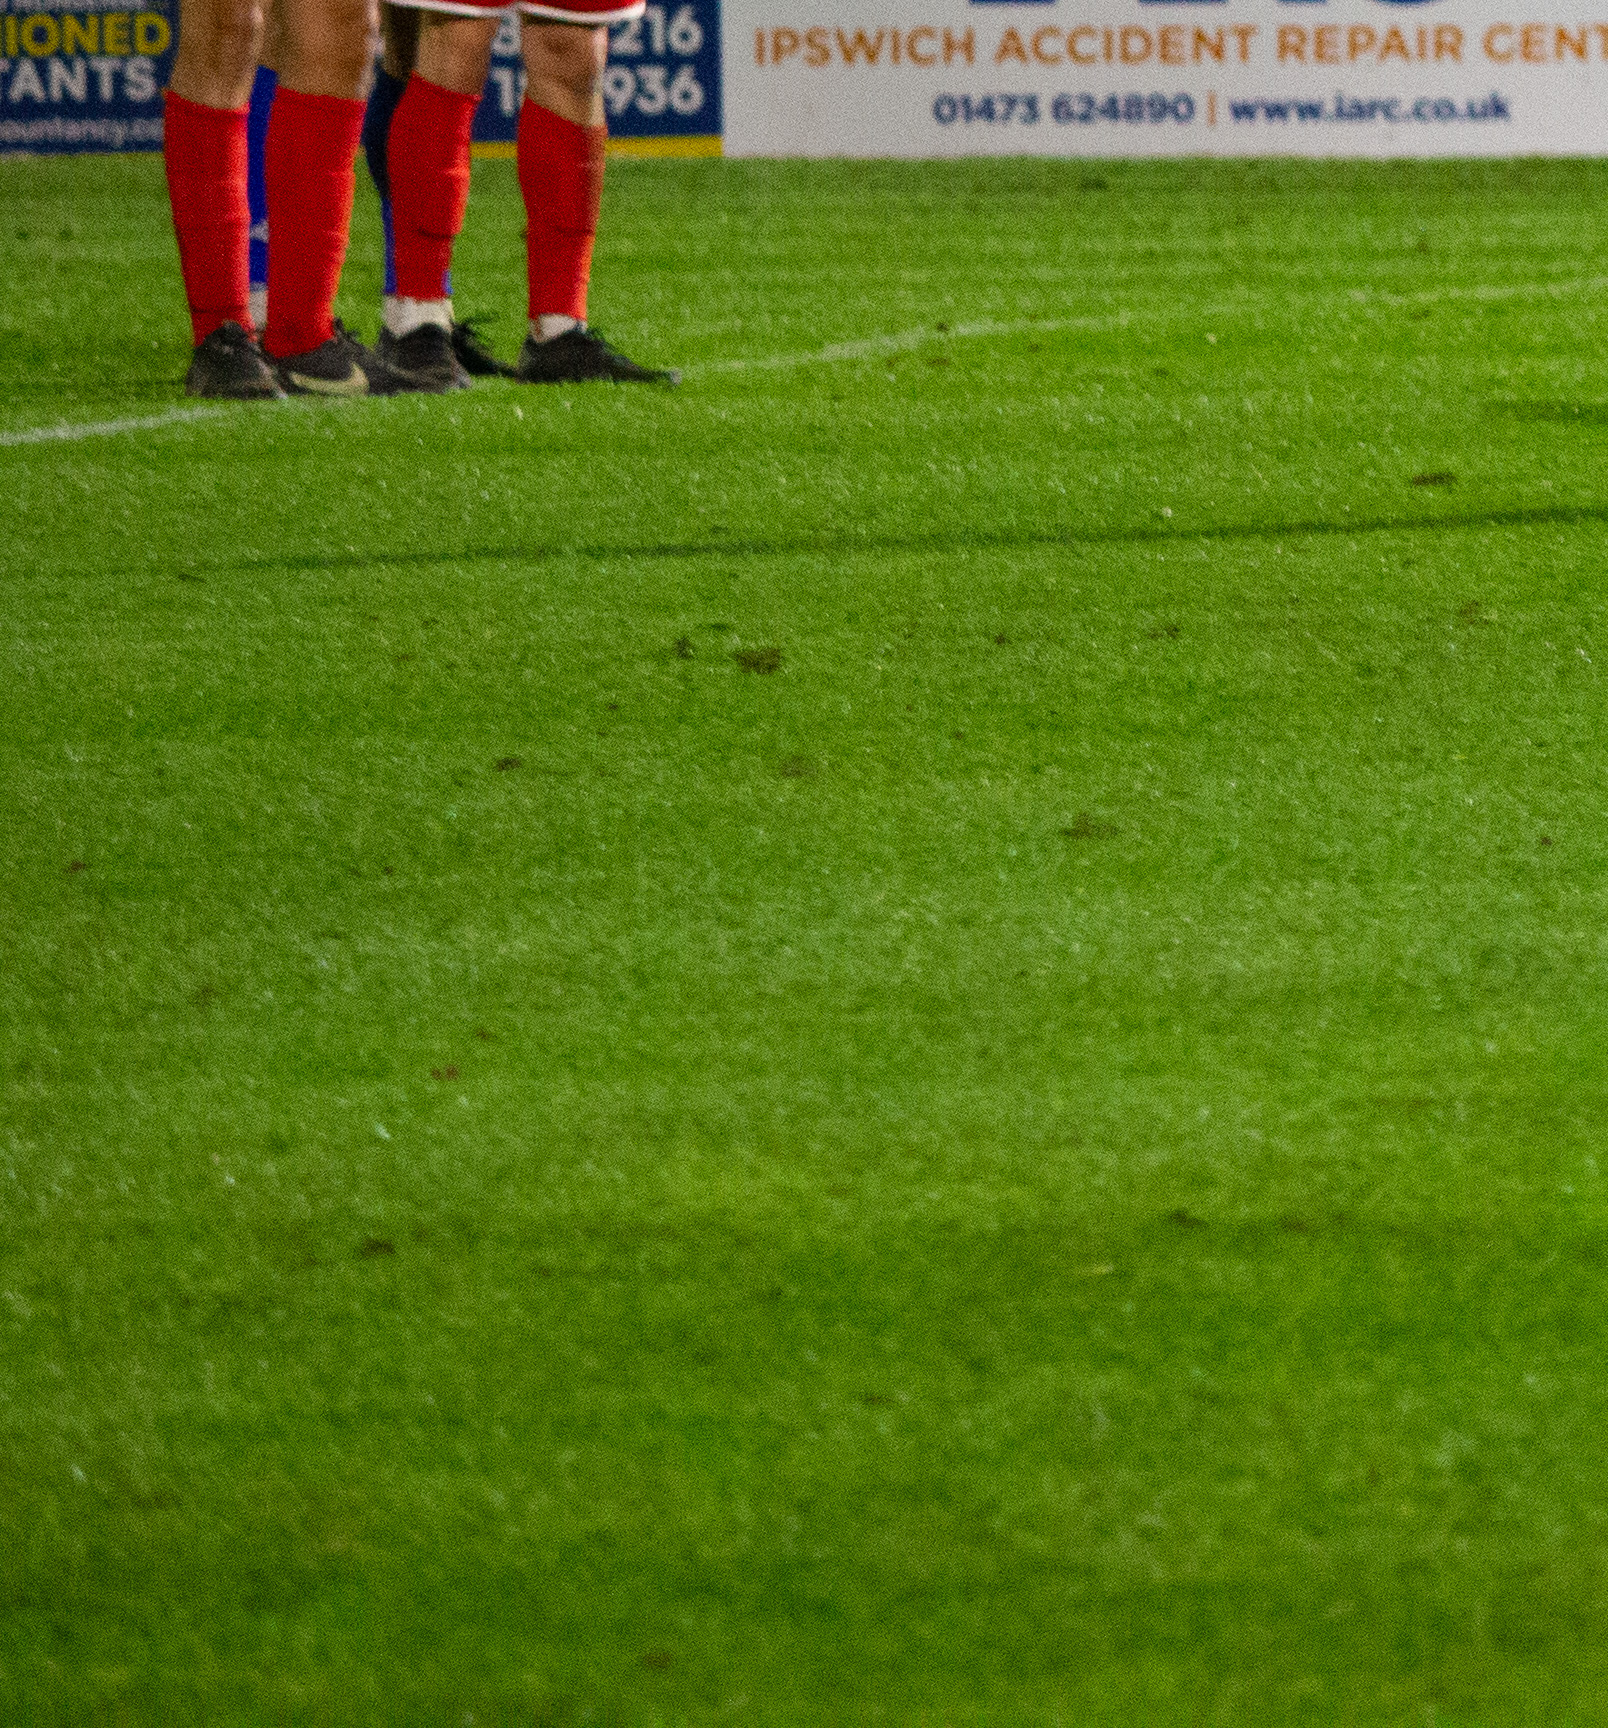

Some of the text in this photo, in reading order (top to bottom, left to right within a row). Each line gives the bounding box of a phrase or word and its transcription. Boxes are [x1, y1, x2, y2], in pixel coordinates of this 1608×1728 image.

[2, 12, 171, 58] IONED
[752, 23, 977, 68] IPSWICH
[992, 22, 1258, 68] ACCIDENT
[1275, 22, 1466, 66] REPAIR
[0, 57, 158, 103] ANTS
[932, 90, 1512, 126] 01473 624890 www.iarc.co.uk
